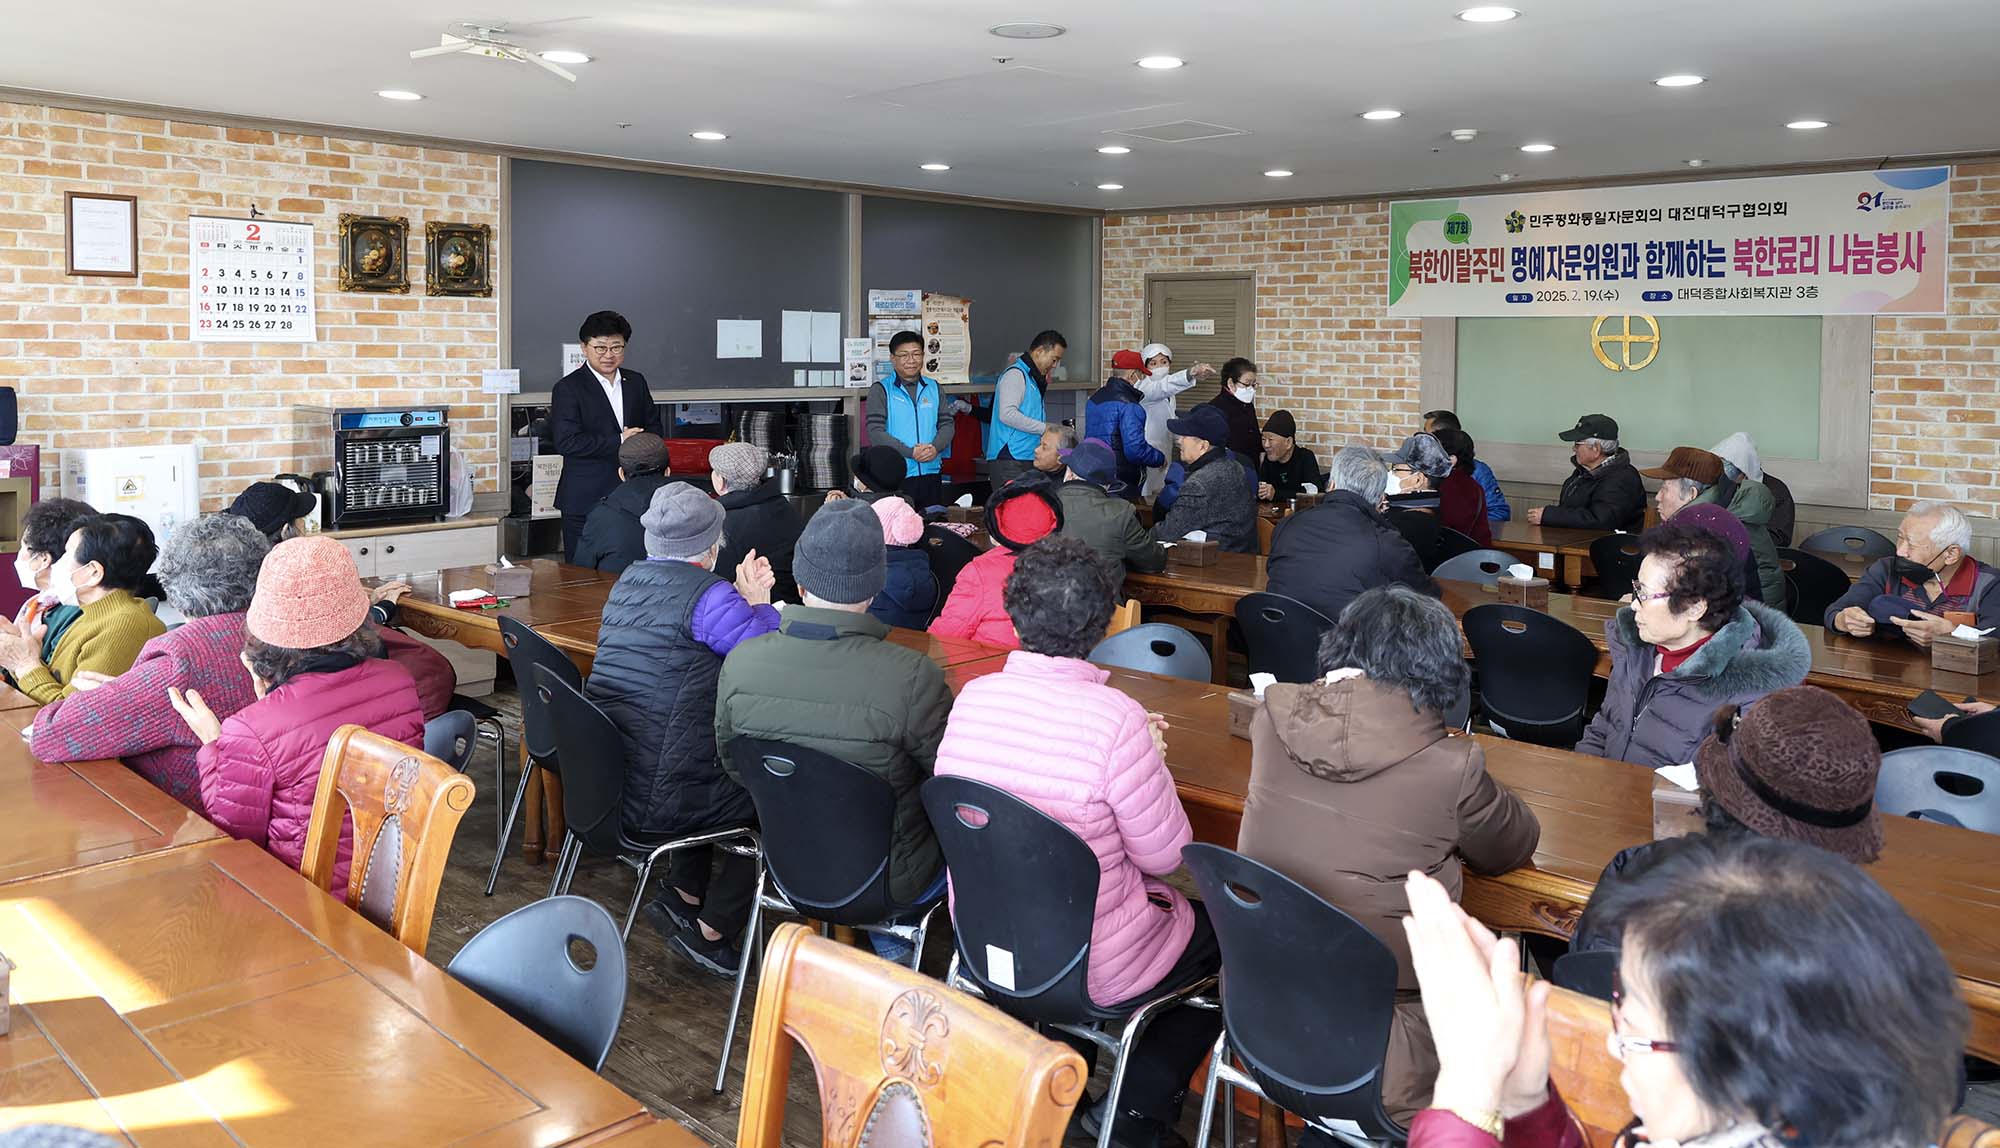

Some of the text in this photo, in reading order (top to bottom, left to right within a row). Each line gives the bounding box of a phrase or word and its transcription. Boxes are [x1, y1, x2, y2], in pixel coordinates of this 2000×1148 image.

[1529, 201, 1788, 228] 민주평화통일자문회의 대전대덕구협의회
[246, 224, 261, 241] 2
[1446, 220, 1469, 235] 제7회
[1409, 230, 1926, 284] 북한이탈주민 명예자문위원과 함께하는 북한료리 나눔봉사
[202, 268, 304, 280] 2 3 4 5 6 7 8
[202, 285, 305, 297] 9 10 11 12 13 14 15
[1536, 291, 1569, 302] 2025.
[1677, 287, 1792, 300] 대덕종합사회복지관
[1796, 286, 1819, 299] 3층
[200, 302, 307, 313] 16 17 18 19 20 21 22
[200, 319, 292, 330] 23 24 25 26 27 28
